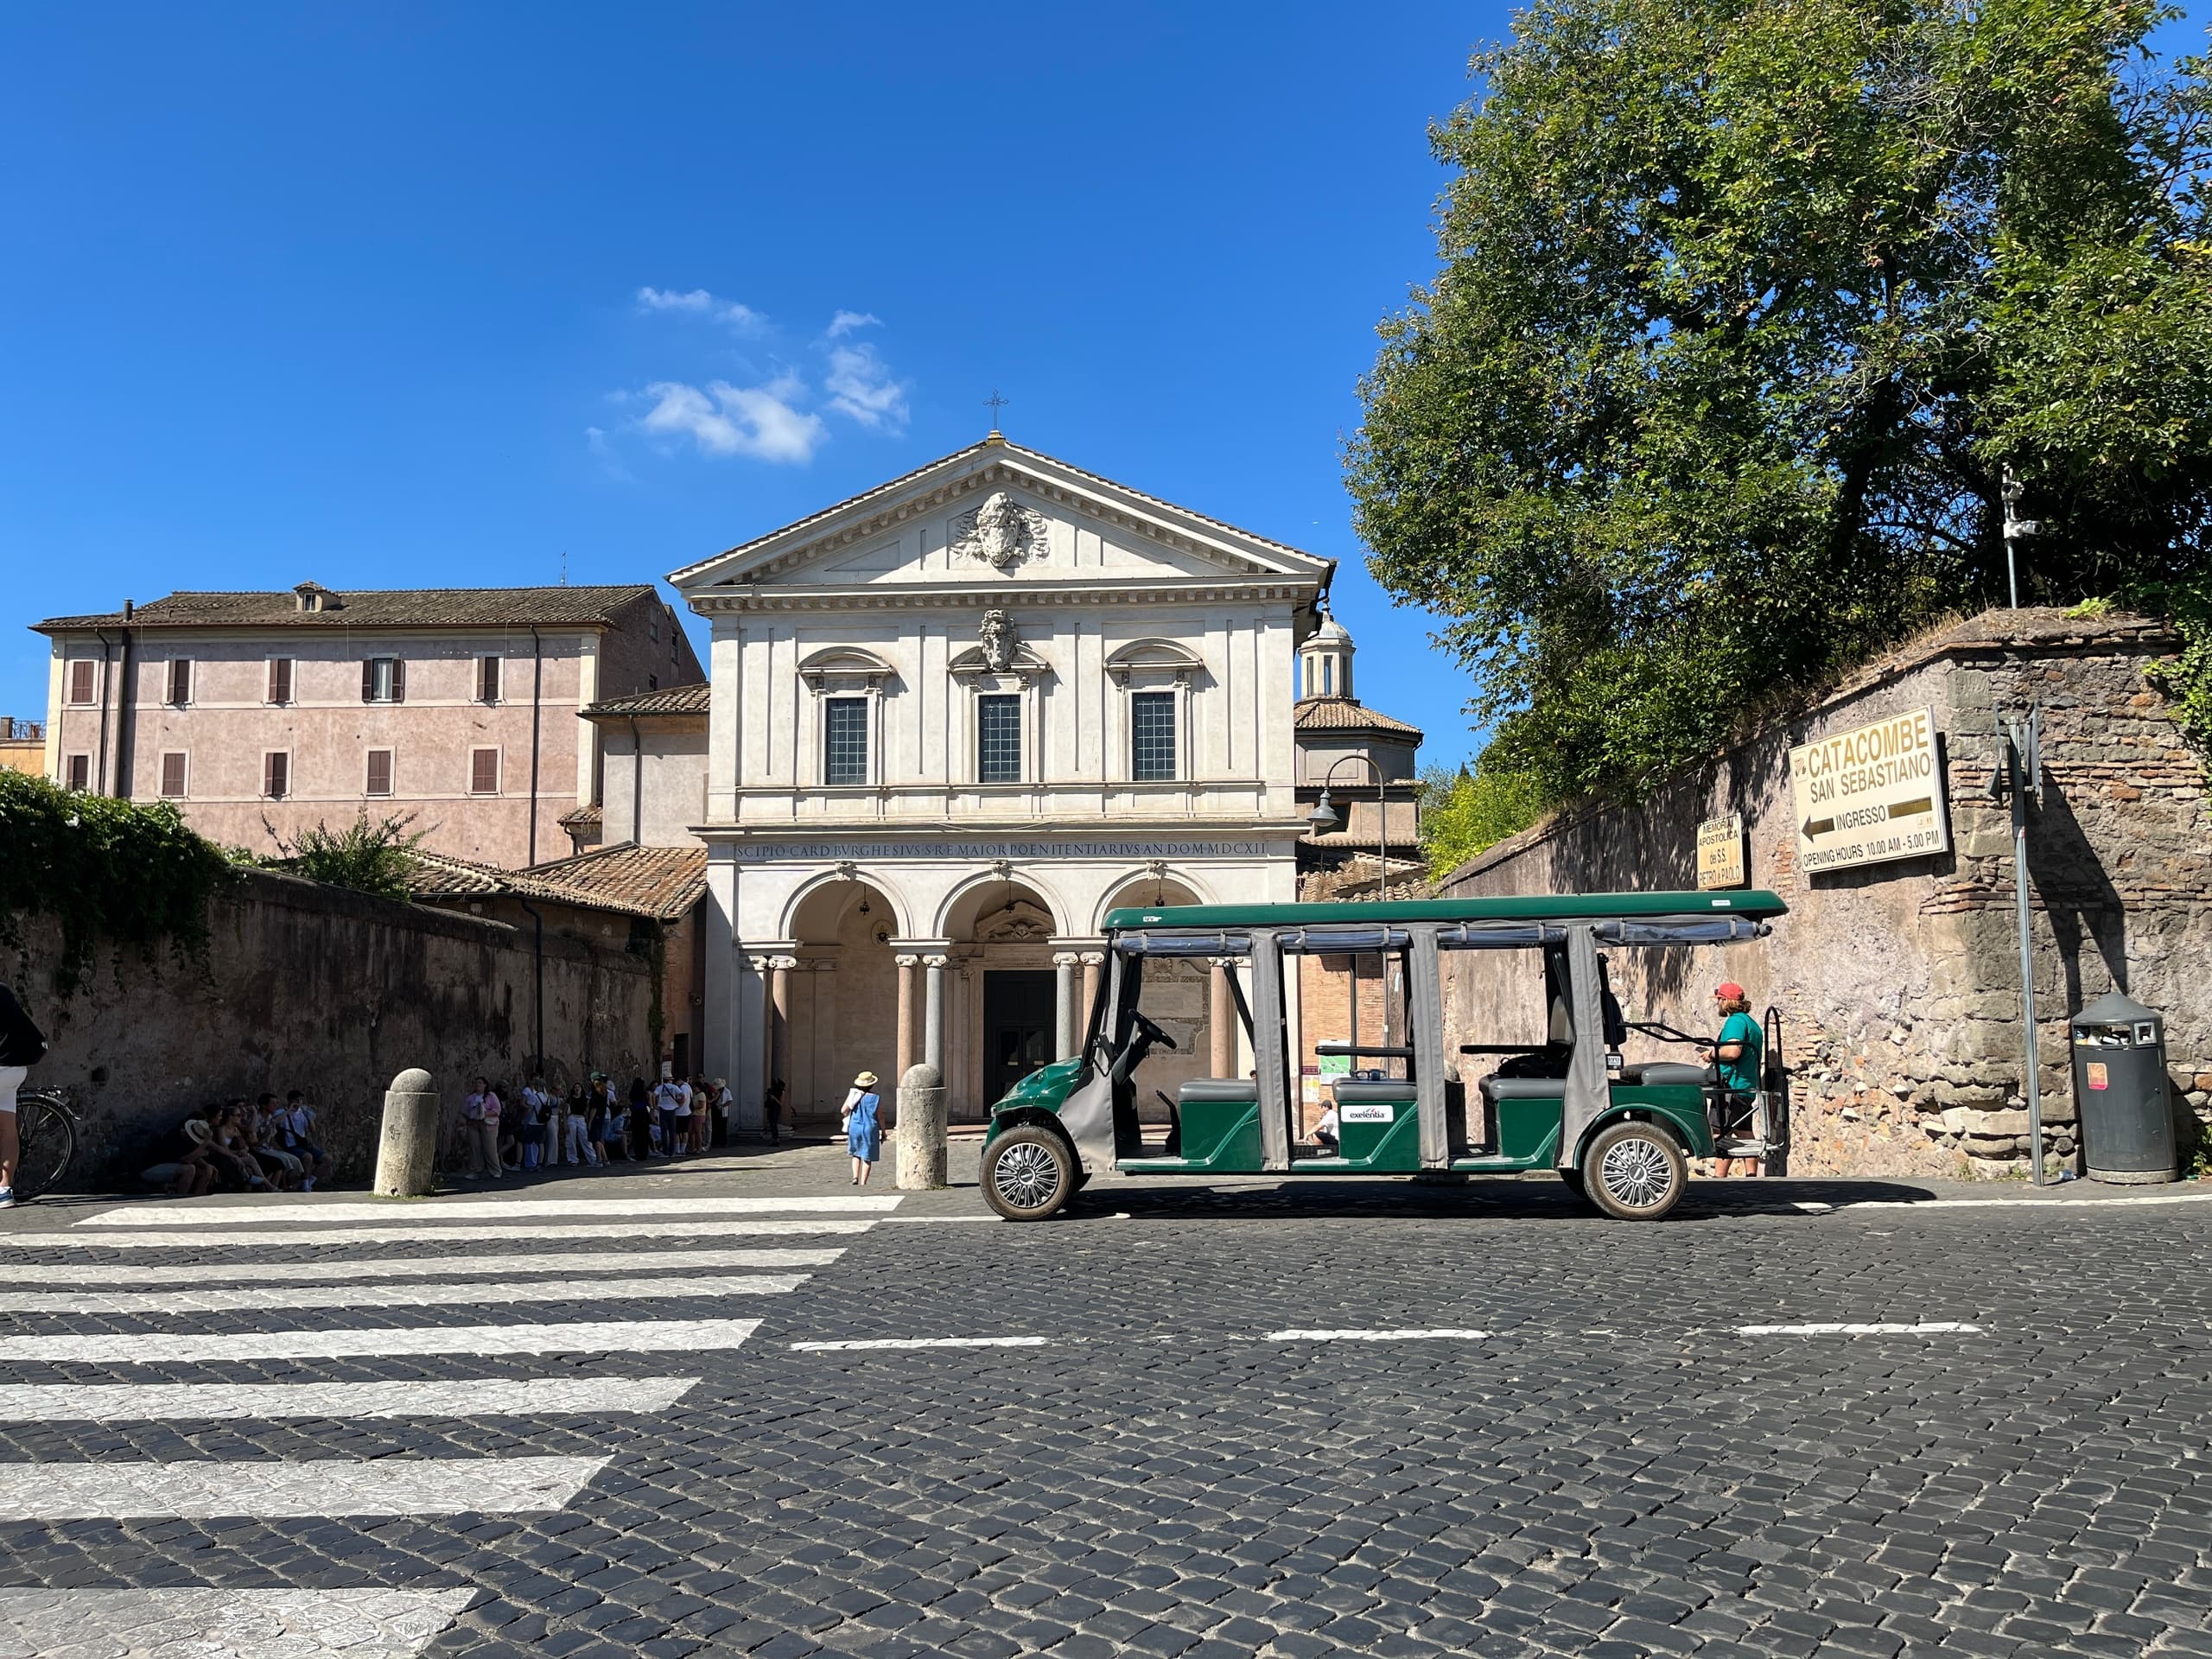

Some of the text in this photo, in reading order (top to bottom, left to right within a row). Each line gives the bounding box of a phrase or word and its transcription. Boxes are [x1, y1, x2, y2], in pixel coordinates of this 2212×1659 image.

[1808, 714, 1929, 779] CATACOMBE
[1810, 752, 1931, 804] SAN SEBASTIANO
[1835, 804, 1886, 831] INGRESSO
[737, 846, 785, 857] SCIPIO
[790, 846, 830, 857] CARD
[835, 845, 920, 856] BVRGHESIVS
[958, 845, 1007, 855] MAIOR
[1010, 844, 1140, 855] POENITENTIARIVS
[1143, 843, 1162, 855] AN
[1167, 843, 1204, 855] DOM
[1208, 843, 1265, 855] MDCXII
[1699, 830, 1738, 846] APOSTOLICA
[1803, 848, 1835, 867] OPENING
[1836, 843, 1864, 861] HOURS
[1866, 840, 1886, 856] 10.00
[1888, 836, 1901, 852] AM
[1907, 833, 1924, 849] 5.00
[1926, 830, 1940, 846] PM
[1700, 869, 1716, 886] PIETRO
[1722, 865, 1740, 881] PAOLO
[1350, 1110, 1385, 1119] exelentia
